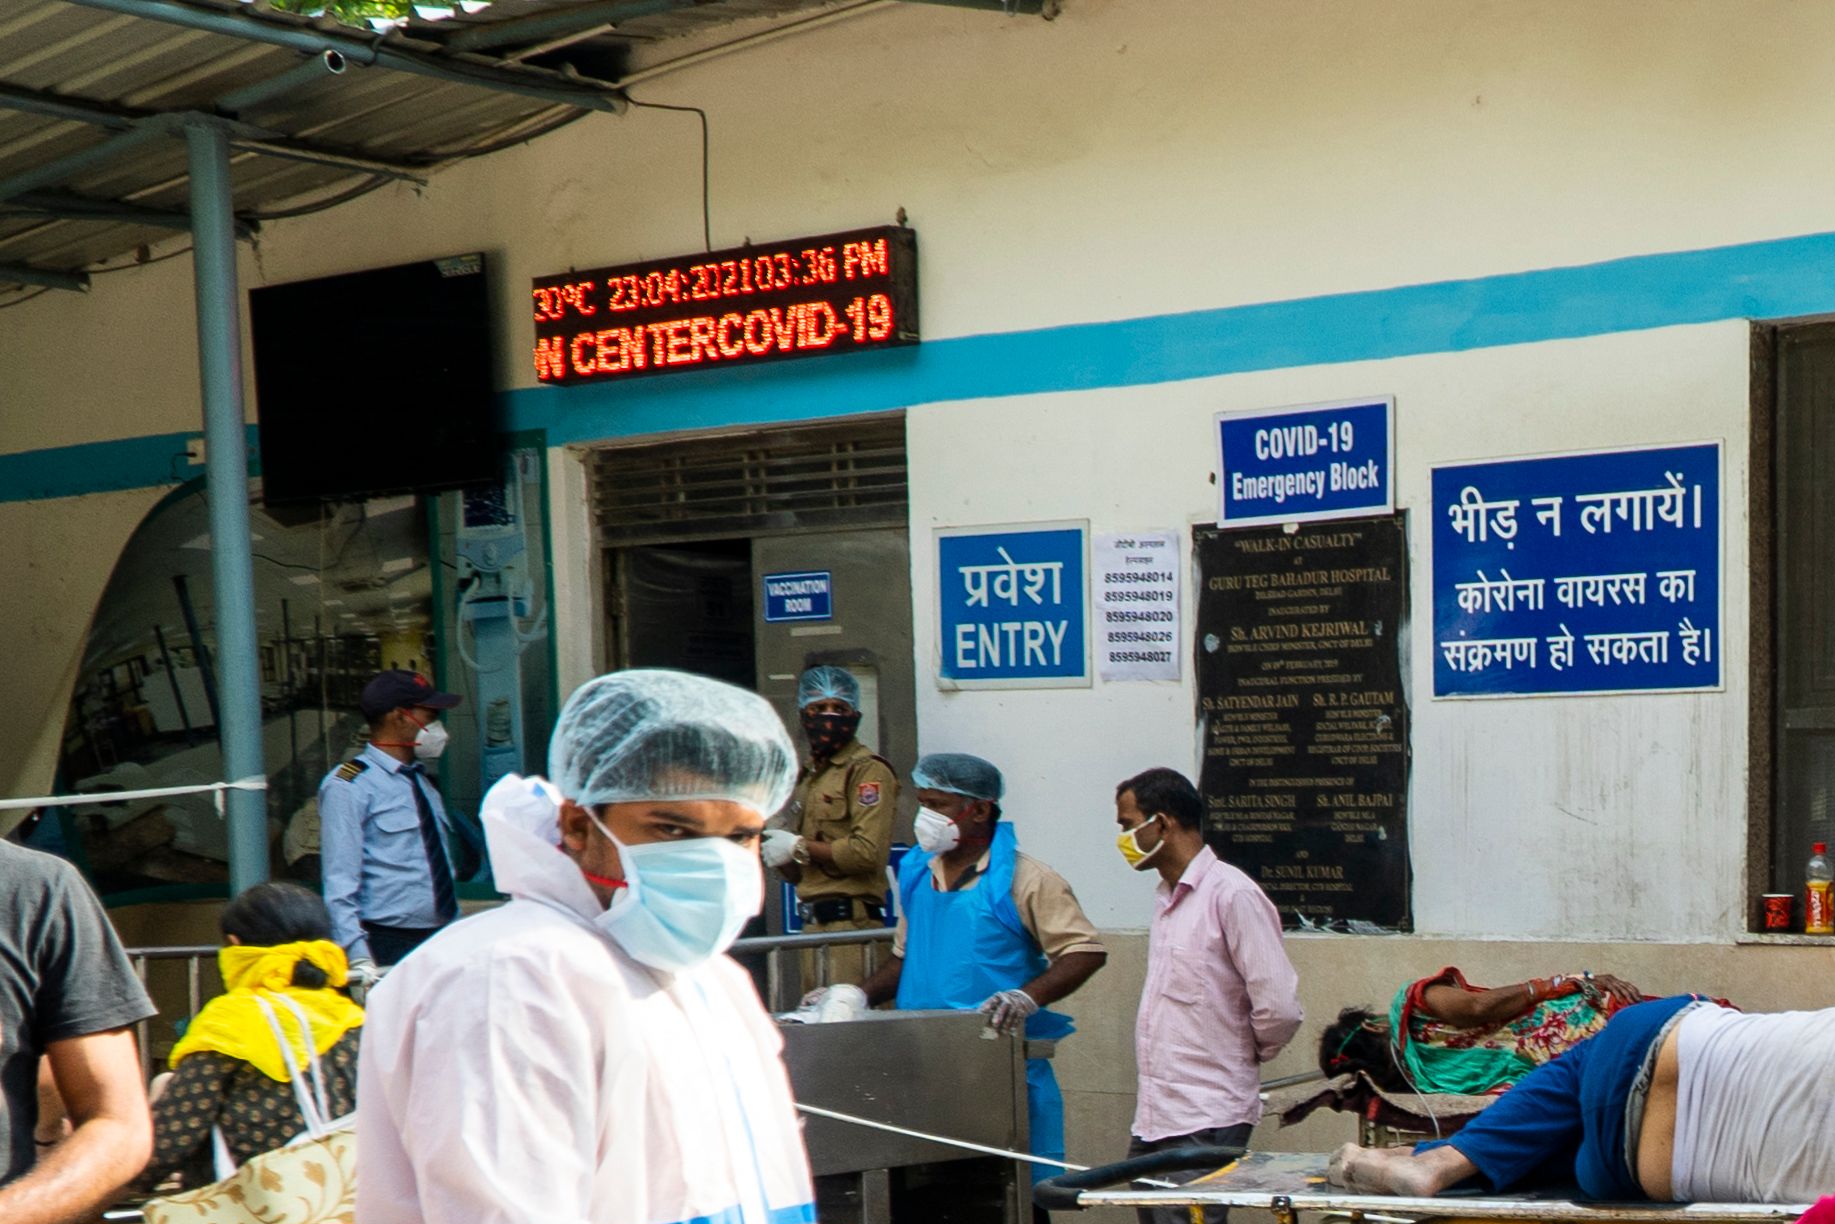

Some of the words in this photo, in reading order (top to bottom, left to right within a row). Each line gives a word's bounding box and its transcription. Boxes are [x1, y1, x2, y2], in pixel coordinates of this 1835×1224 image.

[843, 236, 889, 280] PM
[1255, 421, 1353, 461] COVID-19
[1232, 470, 1325, 503] Emergency
[1330, 459, 1379, 491] Block
[1448, 486, 1520, 550] भीड़
[1531, 497, 1563, 537] न
[958, 546, 1063, 608] प्रवेश
[1104, 571, 1173, 584] 8595948014
[1209, 575, 1242, 591] GURU
[1244, 574, 1268, 588] TEG
[1270, 570, 1328, 587] BAHADUR
[1331, 567, 1391, 583] HOSPITAL
[767, 579, 828, 597] VACCINATION
[1104, 591, 1173, 602] 8595948019
[1455, 568, 1545, 614] कोरोना
[1553, 572, 1647, 608] वायरस
[1656, 570, 1696, 603] का
[784, 598, 812, 613] ROOM
[1106, 611, 1173, 623] 8595948020
[1107, 631, 1173, 643] 8595948026
[1250, 624, 1298, 640] ARVIND
[1301, 621, 1368, 637] KEJRIWAL
[955, 620, 1069, 668] ENTRY
[1440, 630, 1538, 672] संक्रमण
[1546, 623, 1575, 671] हो
[1584, 631, 1670, 666] सकता
[1109, 651, 1172, 663] 8595948027
[1350, 691, 1395, 706] GAUTAM
